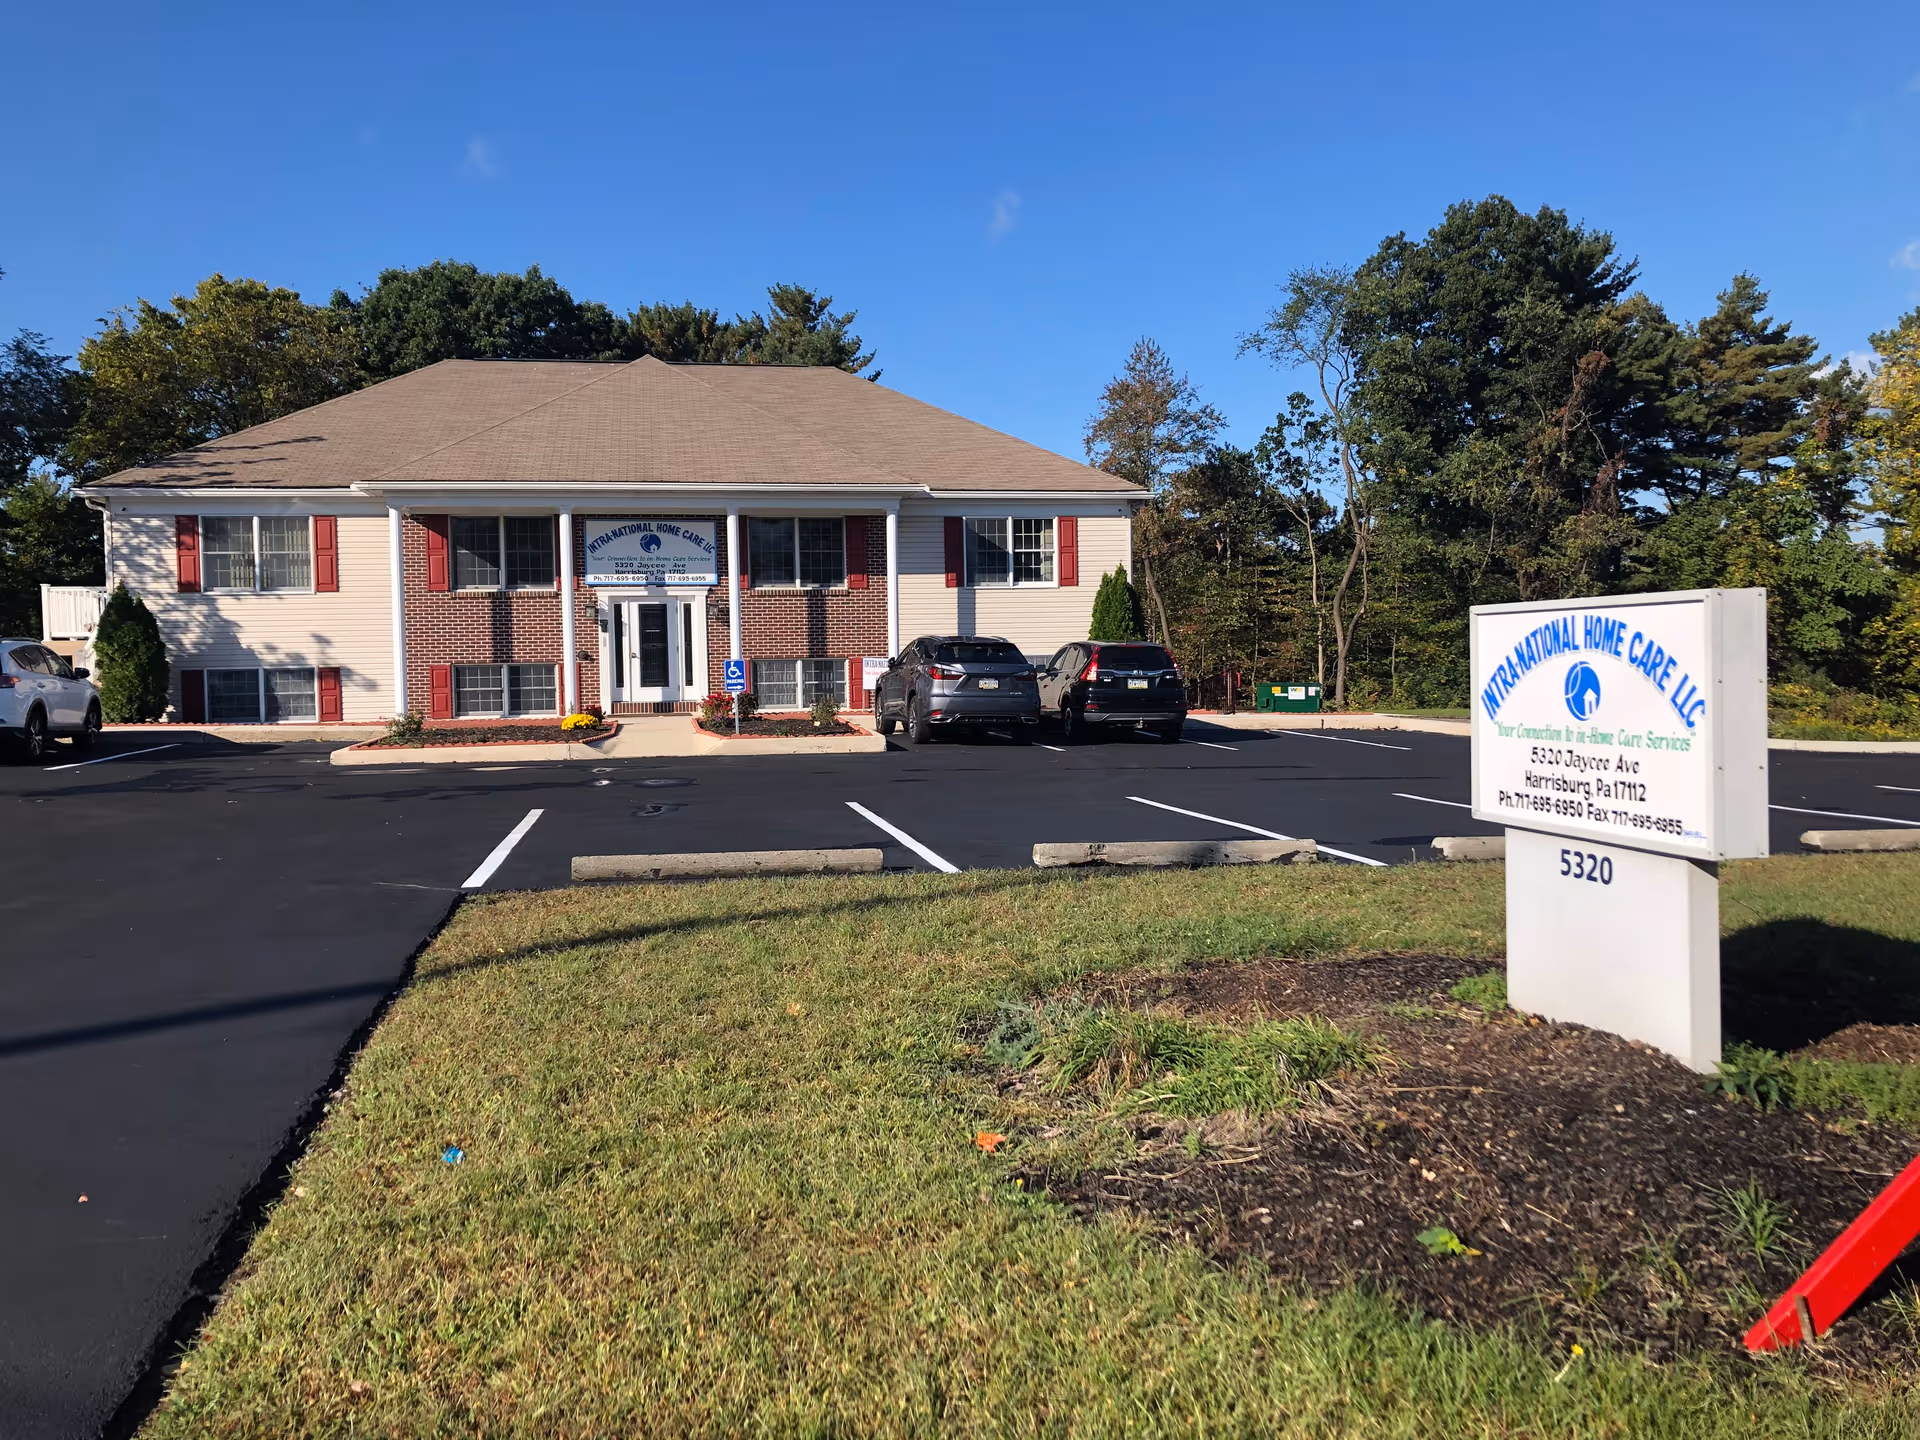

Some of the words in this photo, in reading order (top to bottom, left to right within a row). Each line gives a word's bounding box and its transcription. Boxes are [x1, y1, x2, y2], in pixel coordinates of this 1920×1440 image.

[587, 522, 654, 554] INTRA-NATIONAL
[656, 523, 681, 537] HOME
[682, 530, 706, 548] CARE
[703, 541, 715, 554] LLC
[1481, 615, 1580, 721] INTRA-NATIONAL
[1583, 615, 1627, 658] HOME
[1628, 631, 1677, 693] CARE
[1670, 673, 1705, 728] LLC
[1517, 723, 1562, 741] Connection
[1565, 725, 1574, 742] to
[1618, 728, 1643, 748] Care
[1531, 746, 1562, 766] 5320
[1564, 749, 1610, 773] Jaycee
[1615, 754, 1640, 774] Ave
[1613, 780, 1647, 802] 17112
[1587, 802, 1610, 823] Fax
[1611, 810, 1683, 836] 717-695-6955
[1560, 848, 1613, 885] 5320
